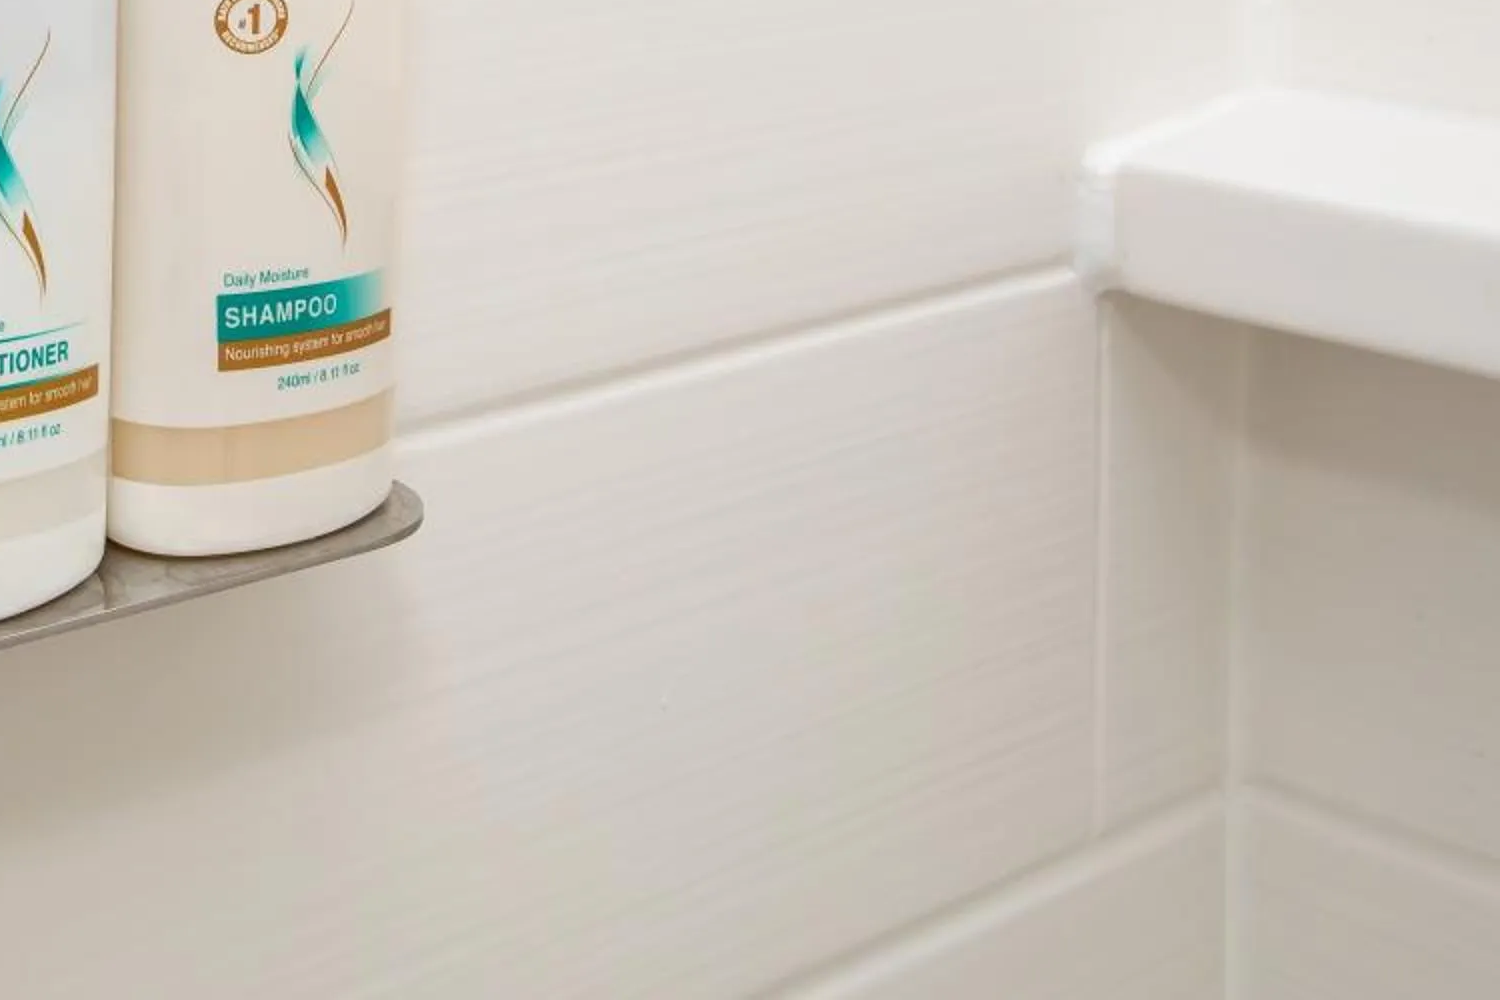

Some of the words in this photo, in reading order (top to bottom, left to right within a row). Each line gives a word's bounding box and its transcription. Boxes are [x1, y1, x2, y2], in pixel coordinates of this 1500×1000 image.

[223, 272, 255, 288] Daily
[259, 267, 309, 284] Moisture
[224, 293, 338, 328] SHAMPOO
[225, 342, 290, 362] Nourishing
[277, 371, 310, 390] 240ml
